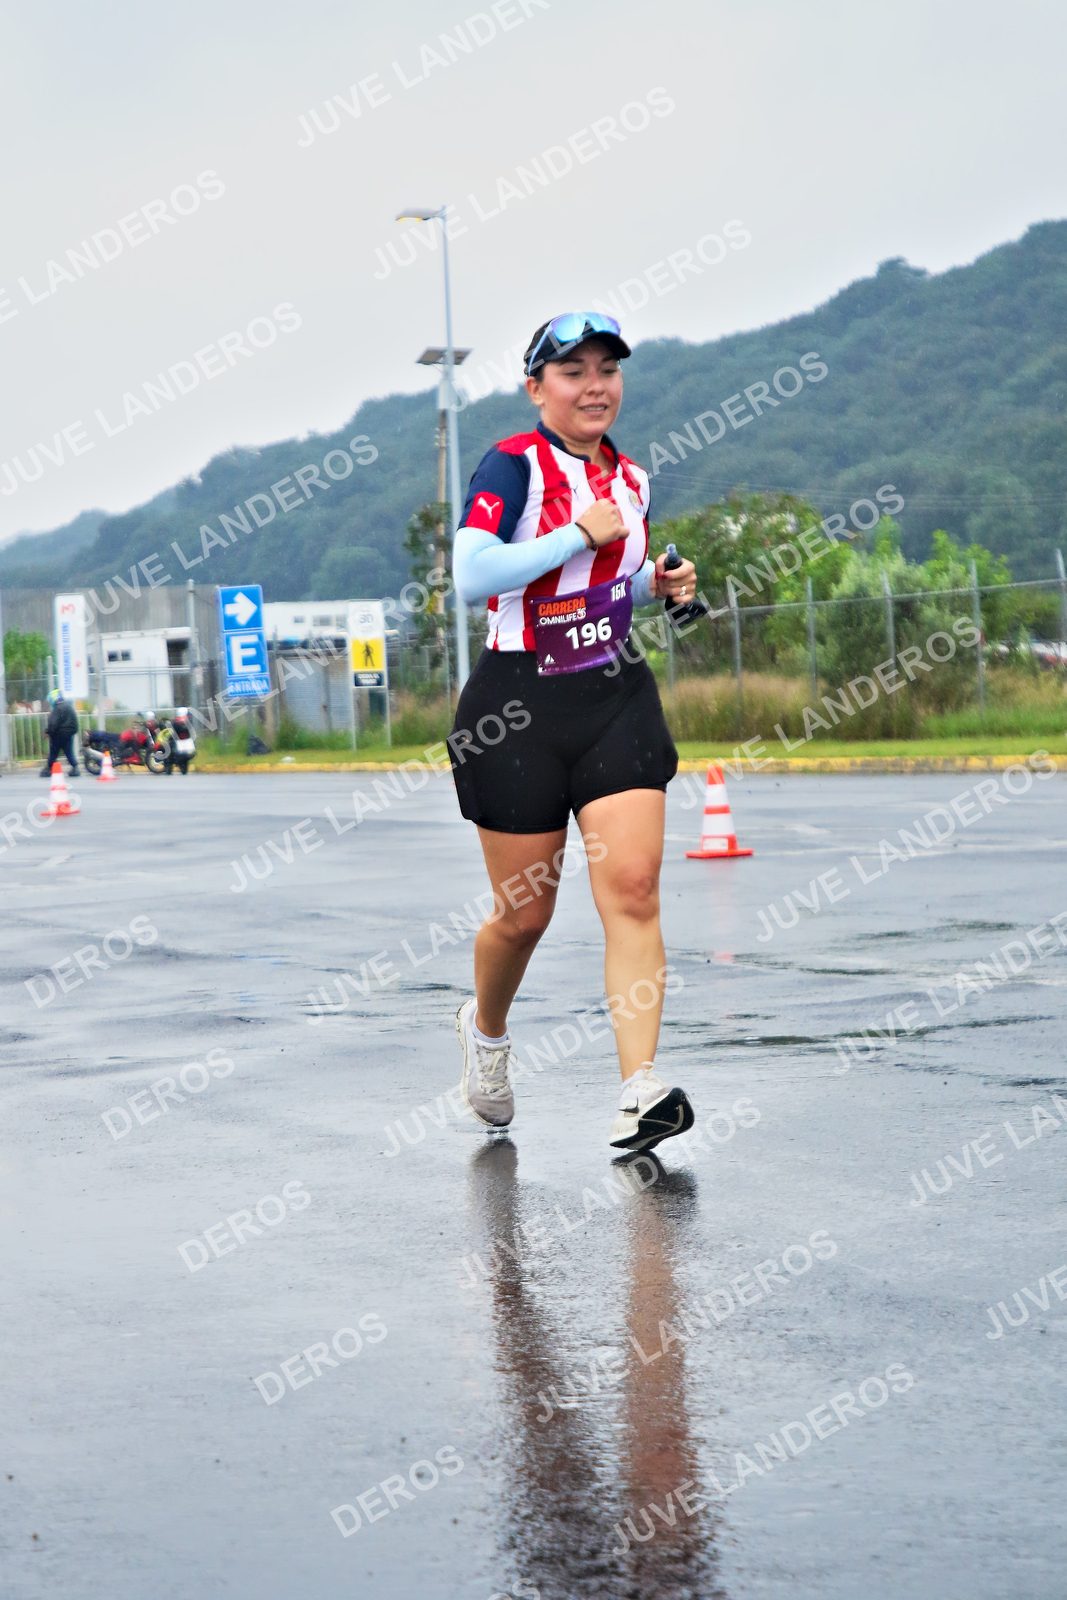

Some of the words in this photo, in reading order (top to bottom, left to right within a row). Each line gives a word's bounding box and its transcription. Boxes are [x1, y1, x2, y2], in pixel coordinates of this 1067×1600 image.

[539, 597, 586, 616] CARRERA
[540, 612, 577, 625] OMNILIFE
[565, 617, 612, 650] 196
[230, 634, 261, 674] E
